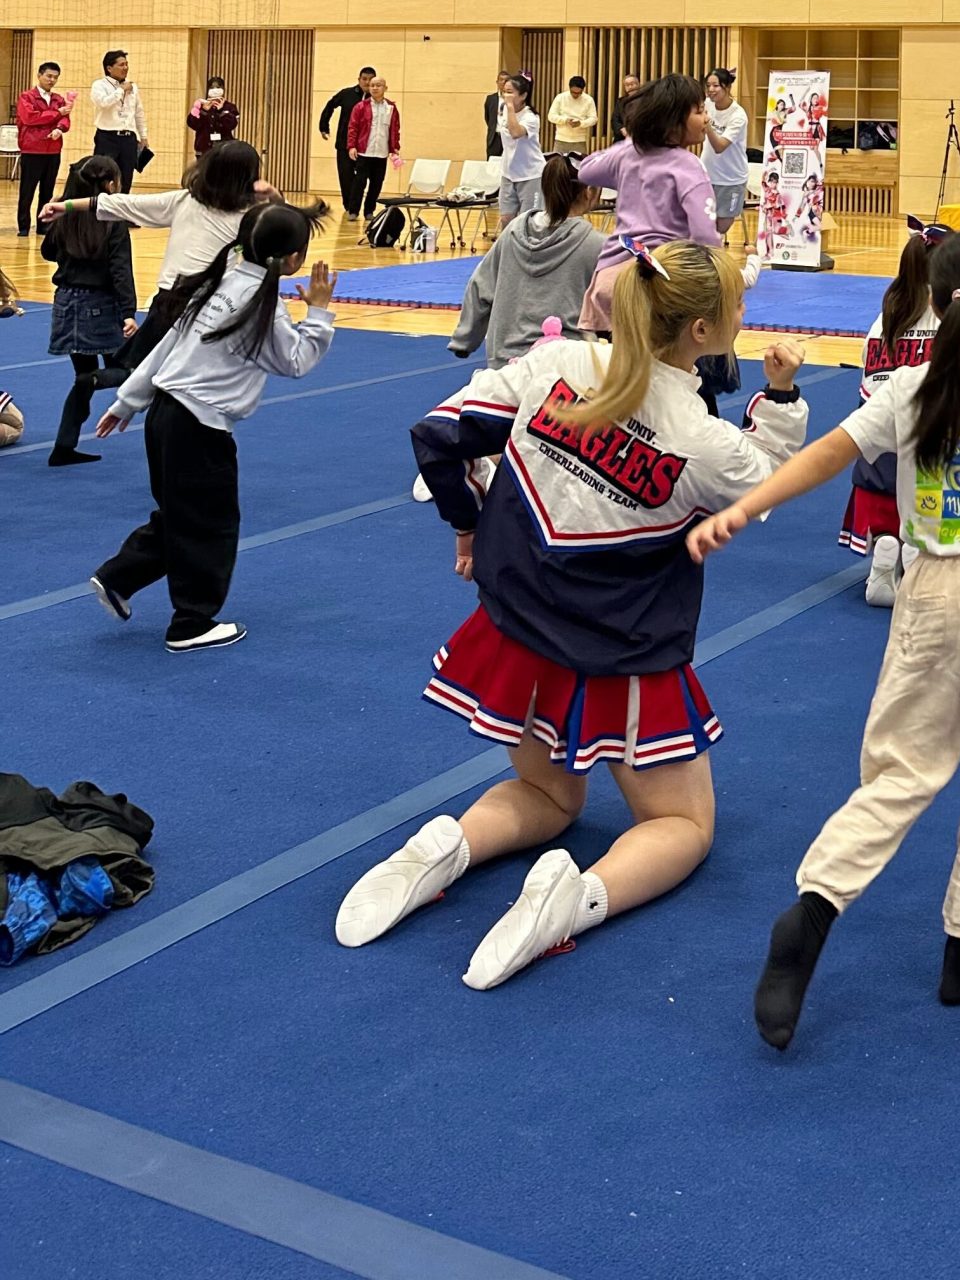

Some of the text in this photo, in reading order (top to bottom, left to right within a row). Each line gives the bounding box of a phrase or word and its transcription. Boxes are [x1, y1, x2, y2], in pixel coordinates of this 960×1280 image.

[865, 337, 934, 377] EAGL
[626, 417, 657, 446] UNIV.
[538, 441, 639, 512] CHEERLEADING TEAM
